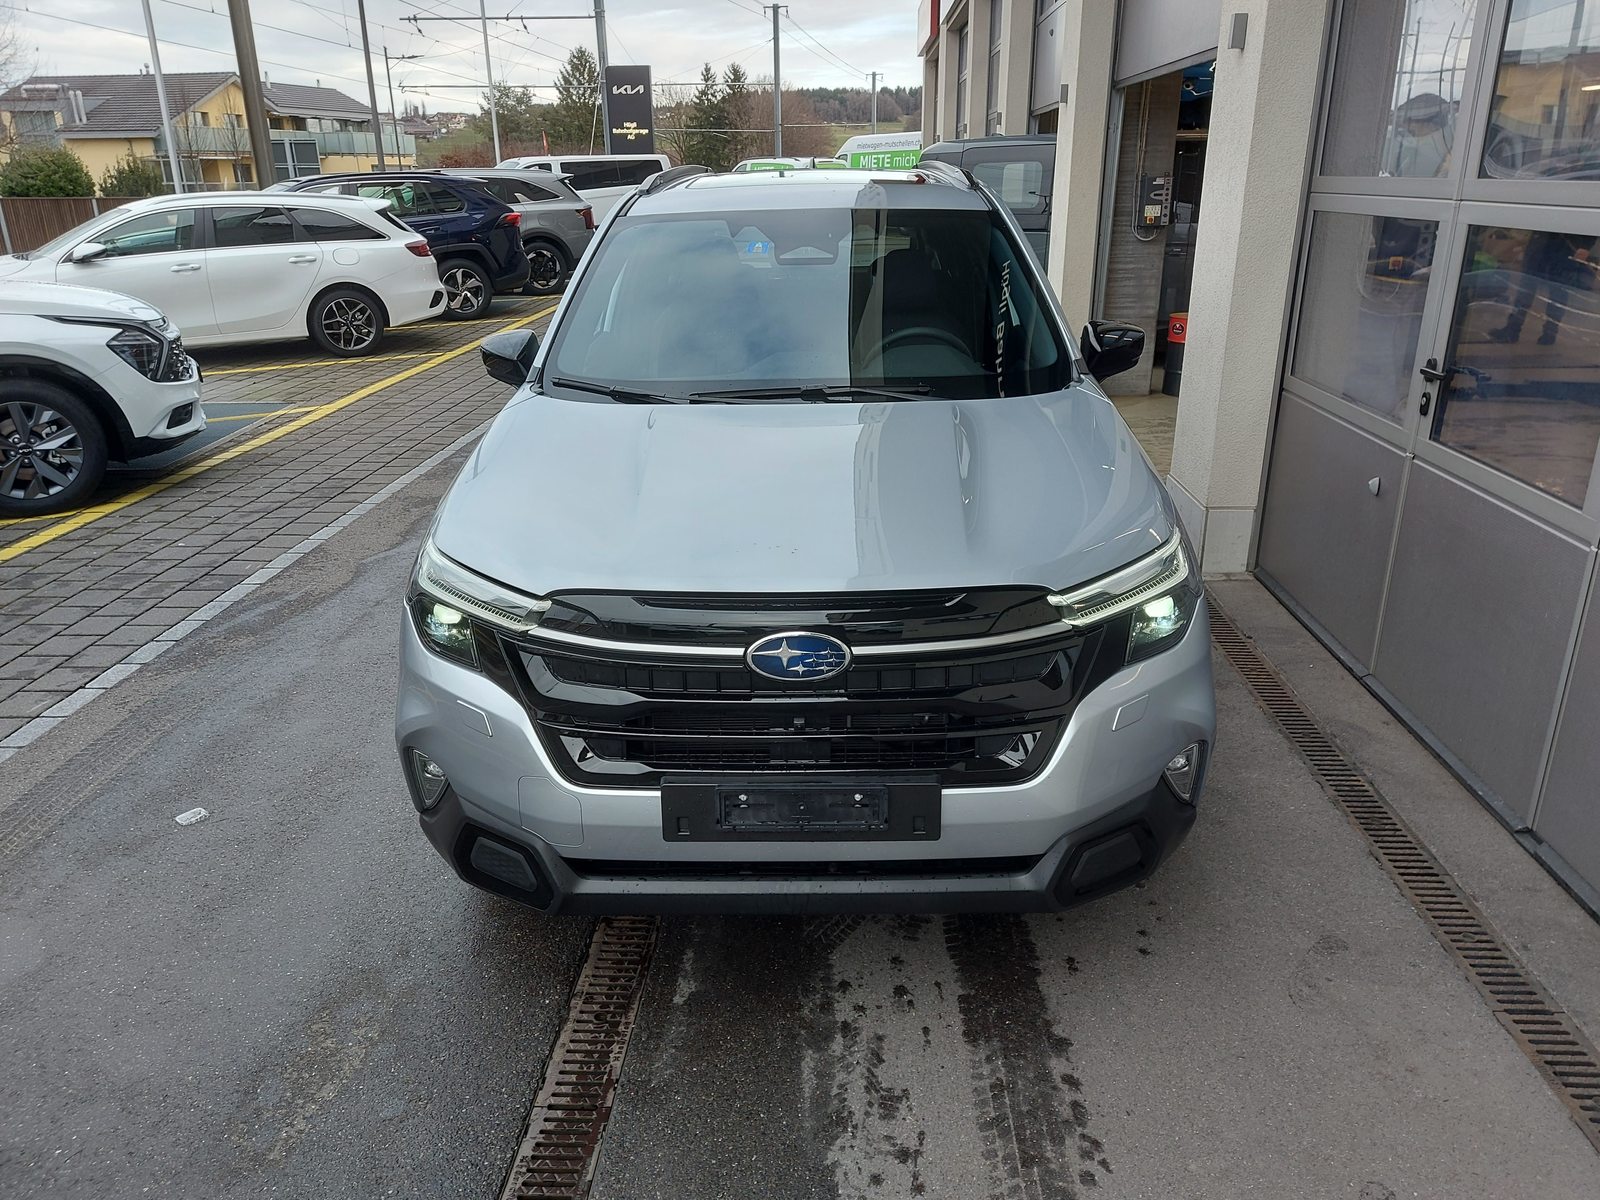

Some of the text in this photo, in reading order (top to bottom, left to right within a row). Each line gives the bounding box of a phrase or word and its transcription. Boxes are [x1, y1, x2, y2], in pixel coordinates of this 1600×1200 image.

[612, 84, 645, 95] KIA
[860, 153, 917, 169] MIETE mich
